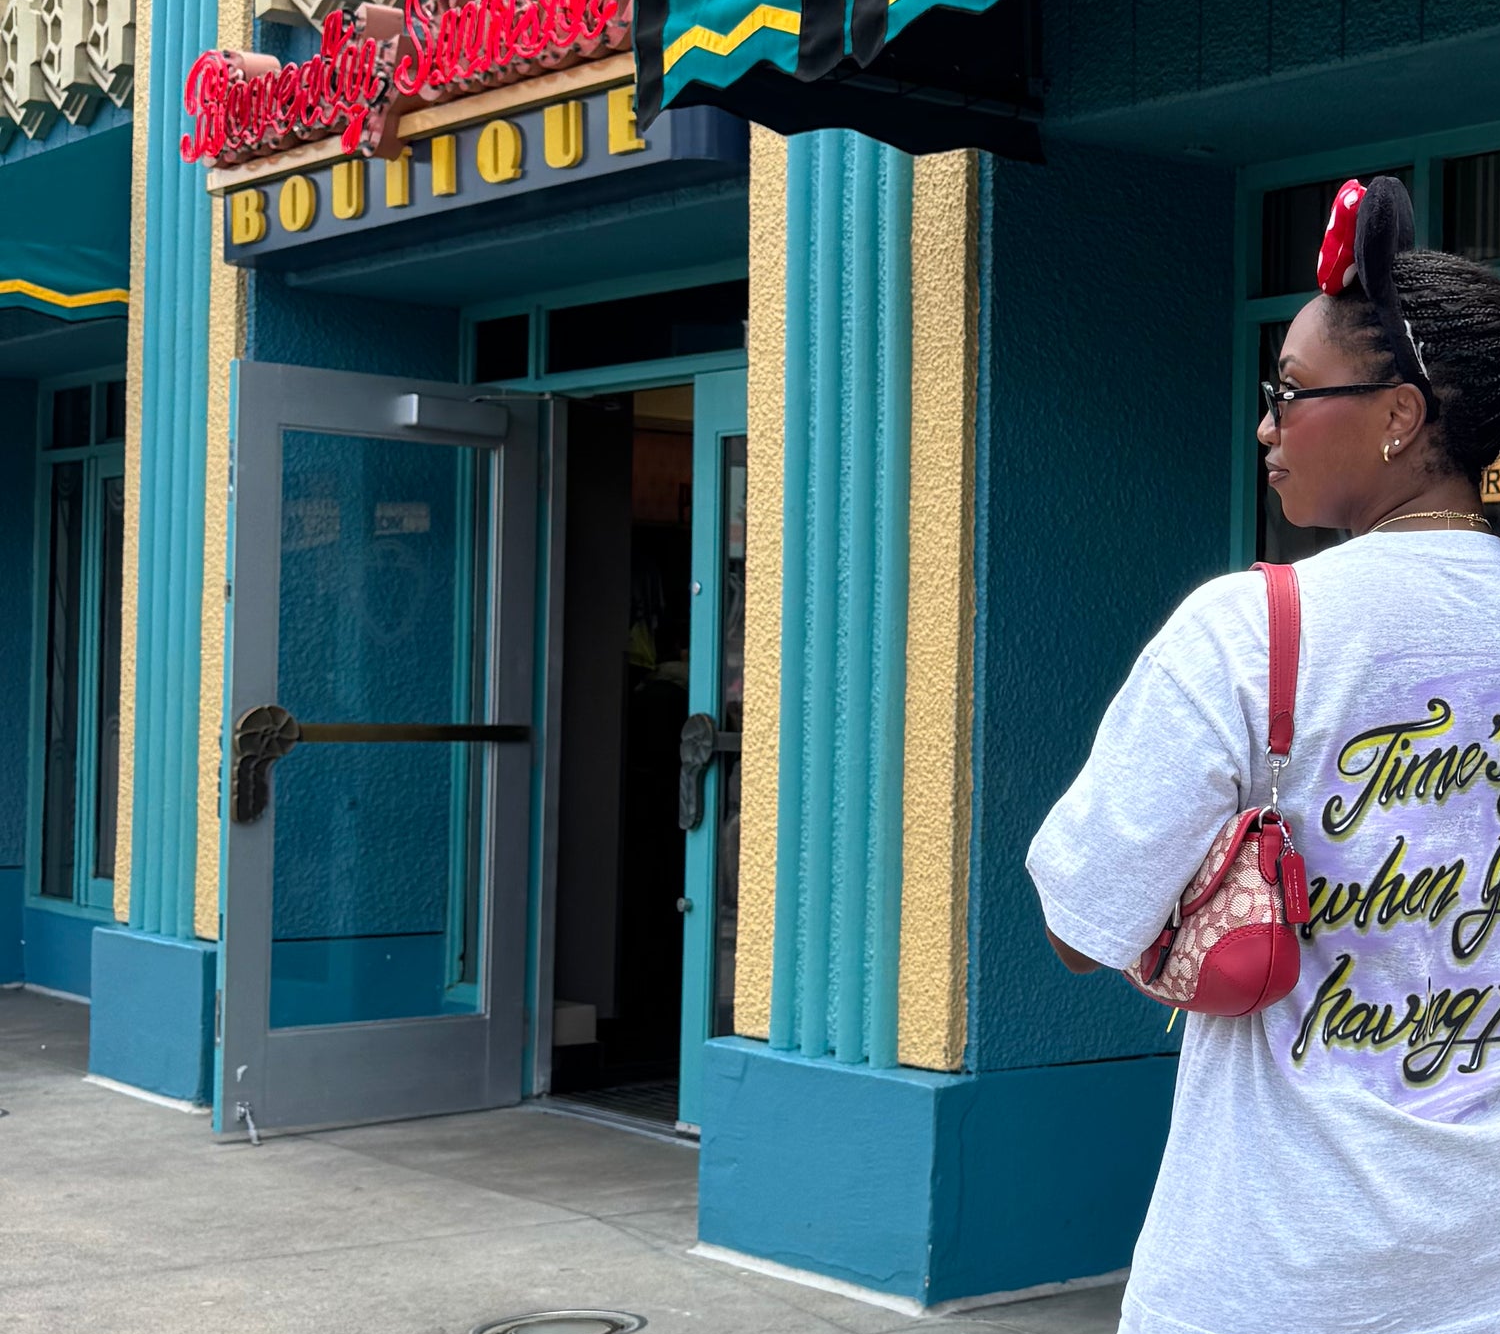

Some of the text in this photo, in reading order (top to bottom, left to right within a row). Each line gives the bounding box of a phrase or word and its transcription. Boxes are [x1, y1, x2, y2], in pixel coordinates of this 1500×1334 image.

[180, 9, 380, 163] Beverly
[231, 84, 646, 245] BOUTIQUE
[1301, 835, 1465, 941] when
